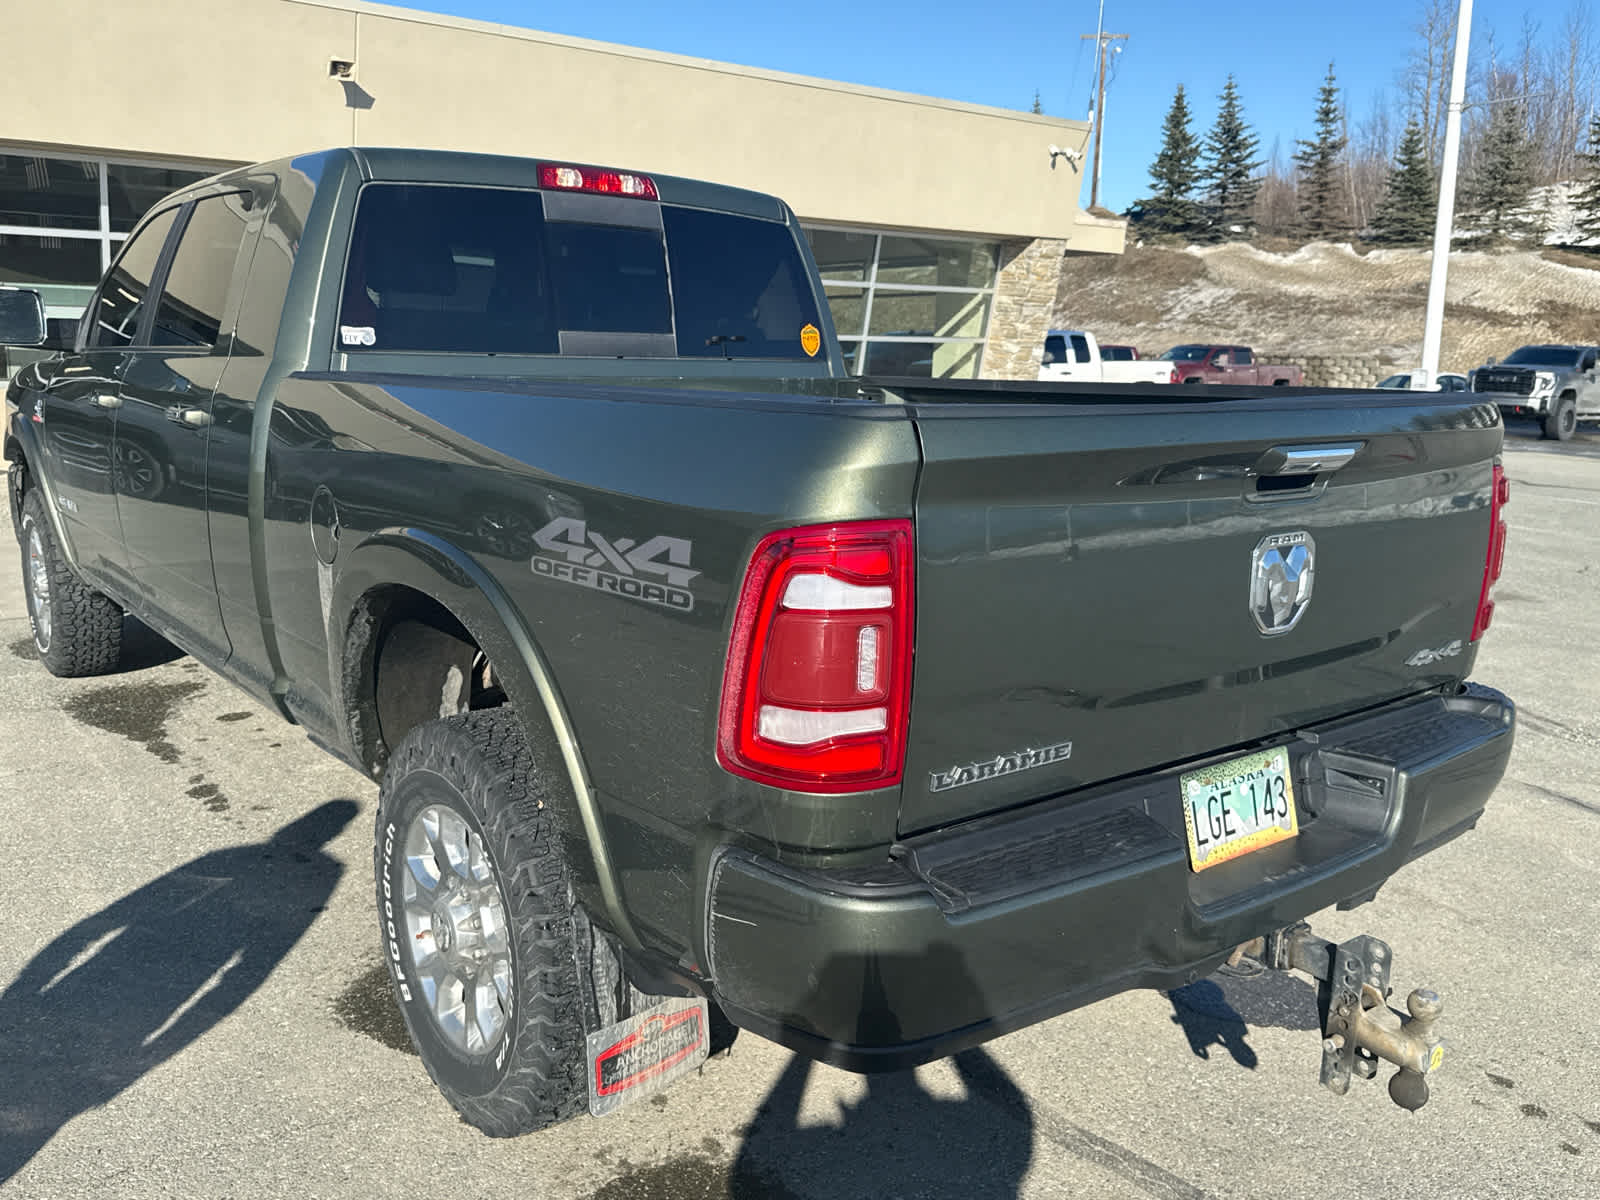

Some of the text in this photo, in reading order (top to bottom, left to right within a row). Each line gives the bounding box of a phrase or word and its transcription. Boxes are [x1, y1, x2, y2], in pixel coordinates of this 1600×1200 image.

[1270, 533, 1305, 545] RAM
[533, 557, 692, 609] OFF ROAD
[929, 741, 1072, 792] LARAMIE
[1191, 775, 1288, 846] LGE 143
[383, 823, 412, 1001] BFGoodrich
